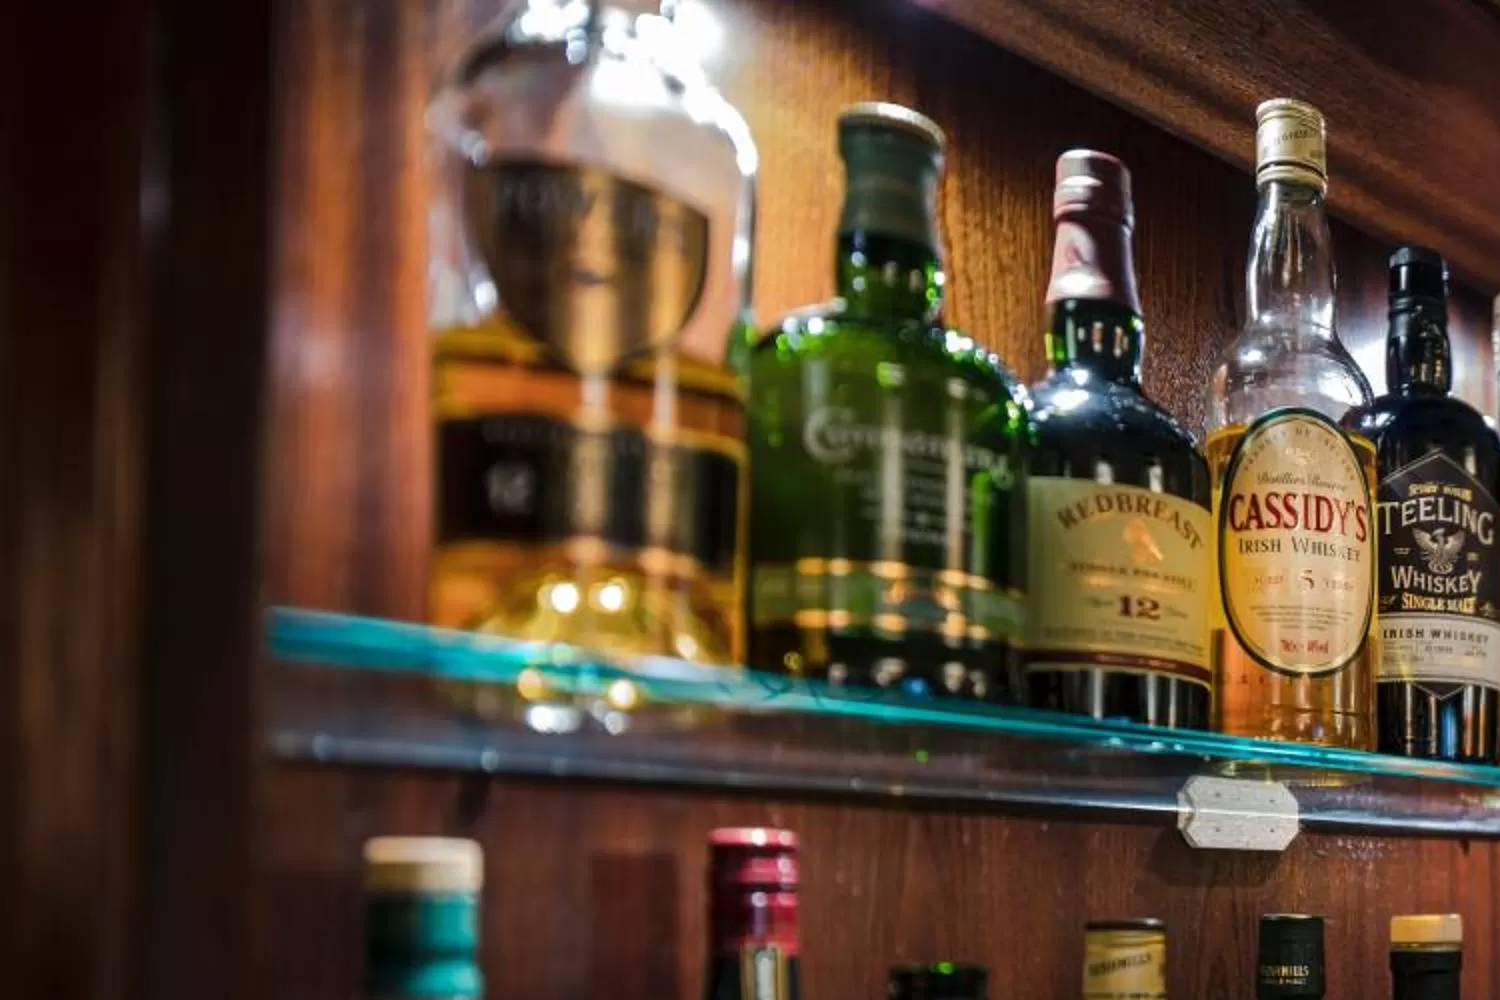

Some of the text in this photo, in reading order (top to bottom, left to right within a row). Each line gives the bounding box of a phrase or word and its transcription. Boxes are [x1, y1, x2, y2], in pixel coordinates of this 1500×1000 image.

[1057, 492, 1203, 550] REDBREAST
[1229, 491, 1367, 543] CASSIDY'S
[1376, 496, 1495, 546] TEELING
[1239, 537, 1282, 555] IRISH
[1391, 564, 1482, 595] WHISKEY
[1119, 595, 1161, 621] 12
[1382, 627, 1489, 644] IRISH WHISKEY
